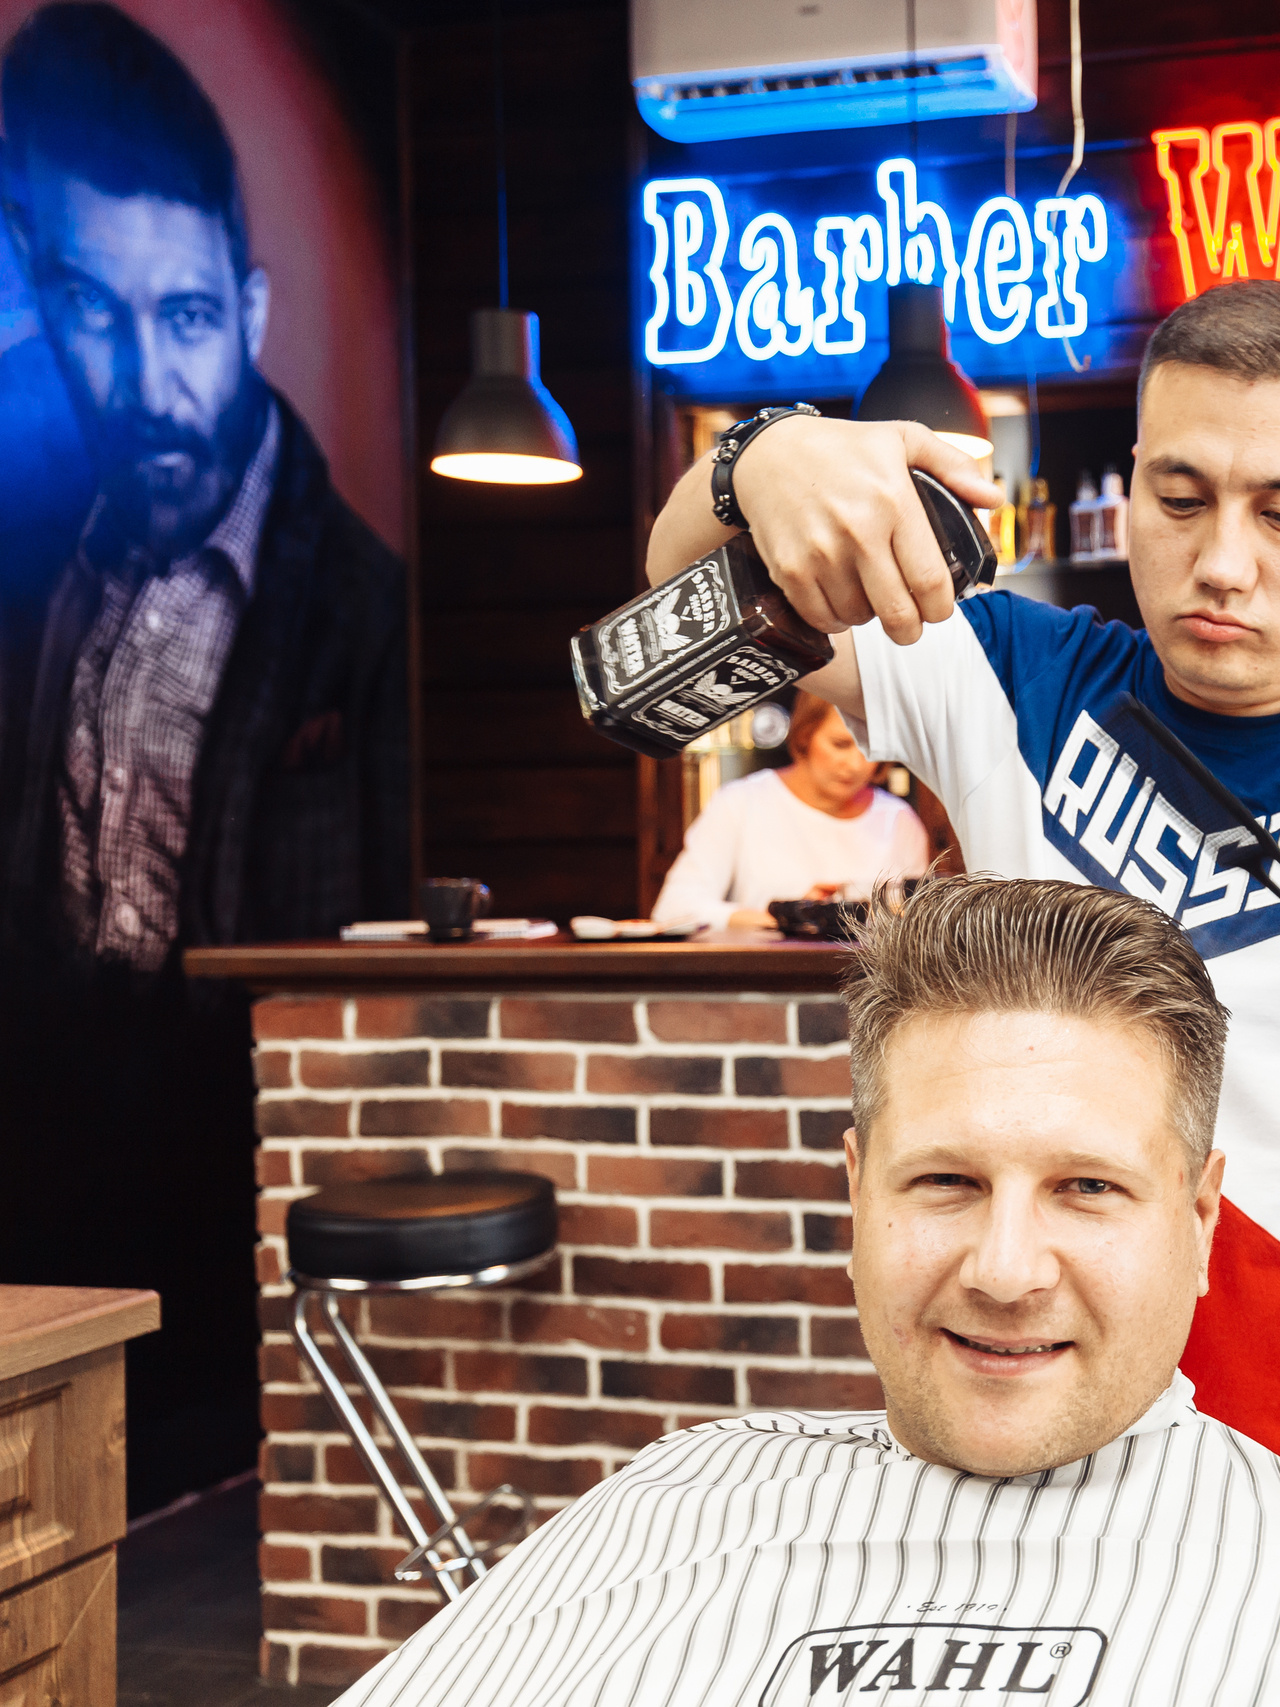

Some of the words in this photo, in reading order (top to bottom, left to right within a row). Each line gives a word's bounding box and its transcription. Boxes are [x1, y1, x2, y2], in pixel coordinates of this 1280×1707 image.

[642, 157, 1108, 365] Barber
[688, 594, 704, 621] SHOP
[691, 572, 716, 634] BARBER
[620, 617, 646, 677] WATER
[726, 655, 781, 685] BARBER
[732, 667, 760, 681] SHOP
[657, 699, 711, 727] WATER
